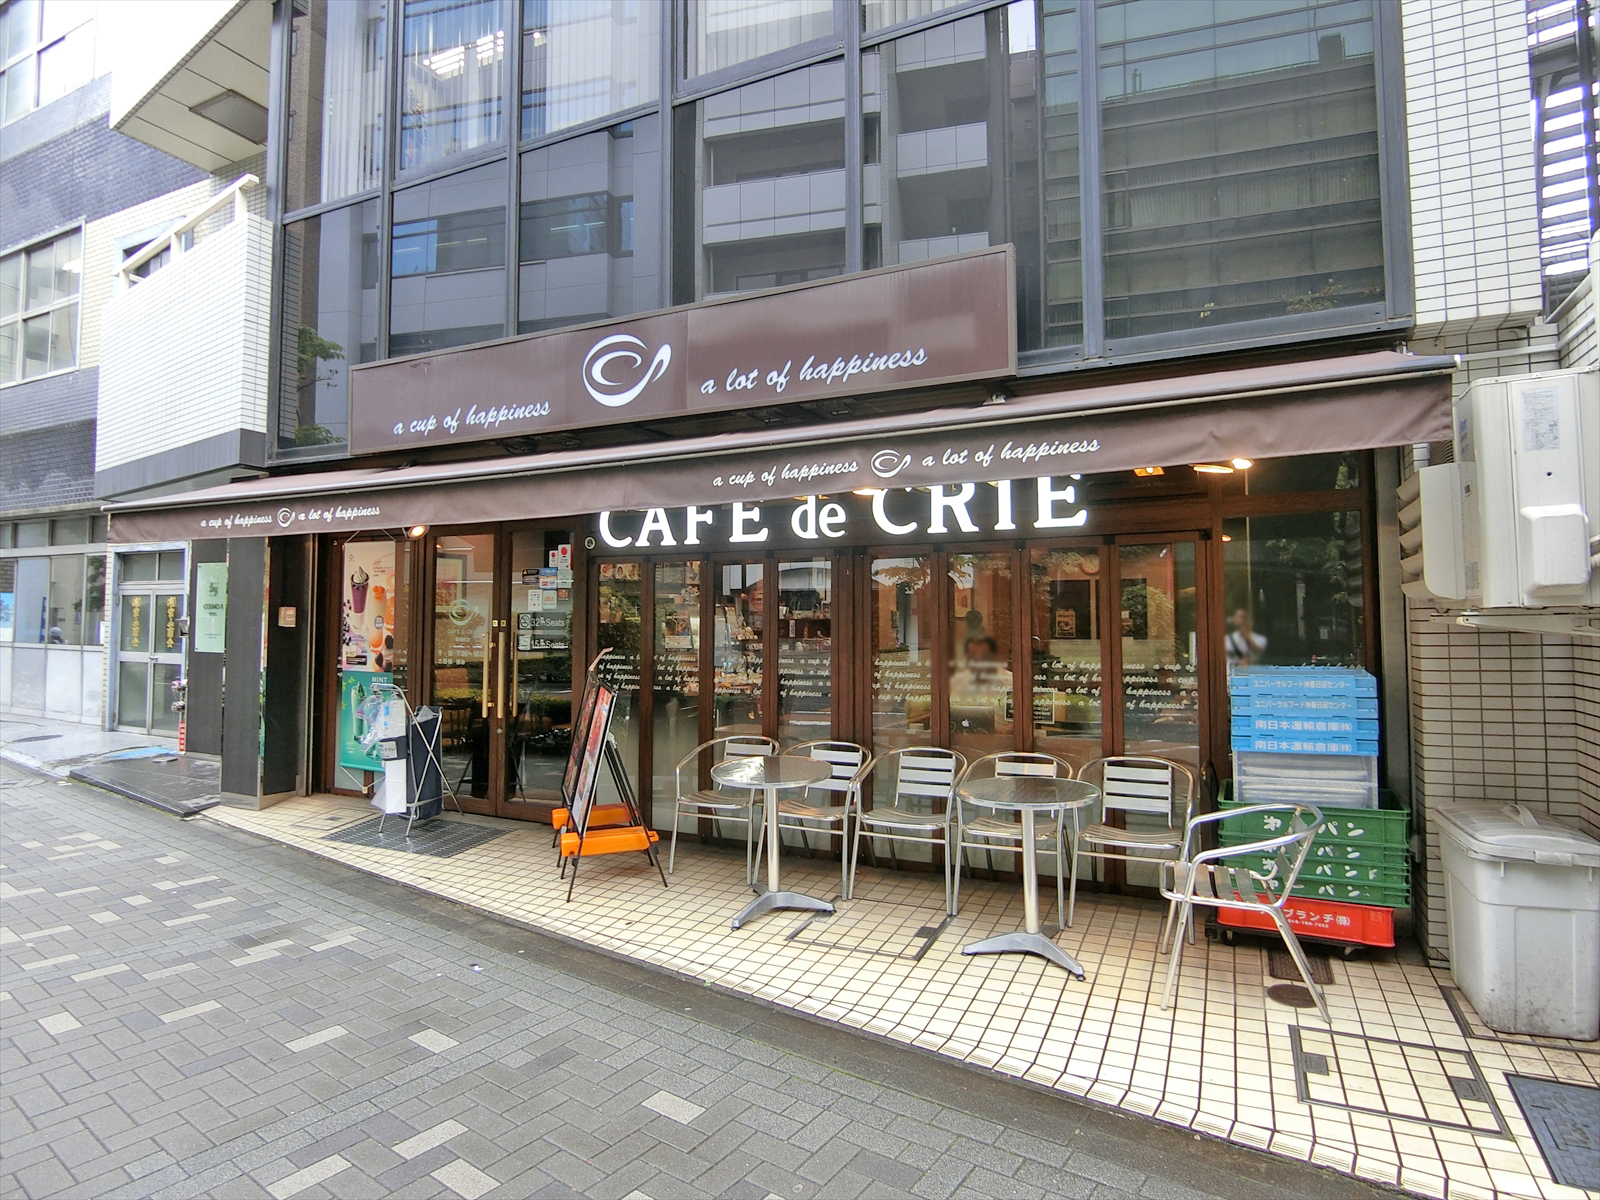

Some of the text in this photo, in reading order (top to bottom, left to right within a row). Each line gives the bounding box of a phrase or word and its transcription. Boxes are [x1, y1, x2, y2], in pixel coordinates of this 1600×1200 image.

[700, 348, 928, 394] a lot of happiness
[393, 401, 551, 436] a cup of happiness
[922, 439, 1100, 467] a lot of happiness
[713, 460, 859, 489] a cup of happiness
[335, 505, 381, 520] happiness
[790, 495, 847, 539] de
